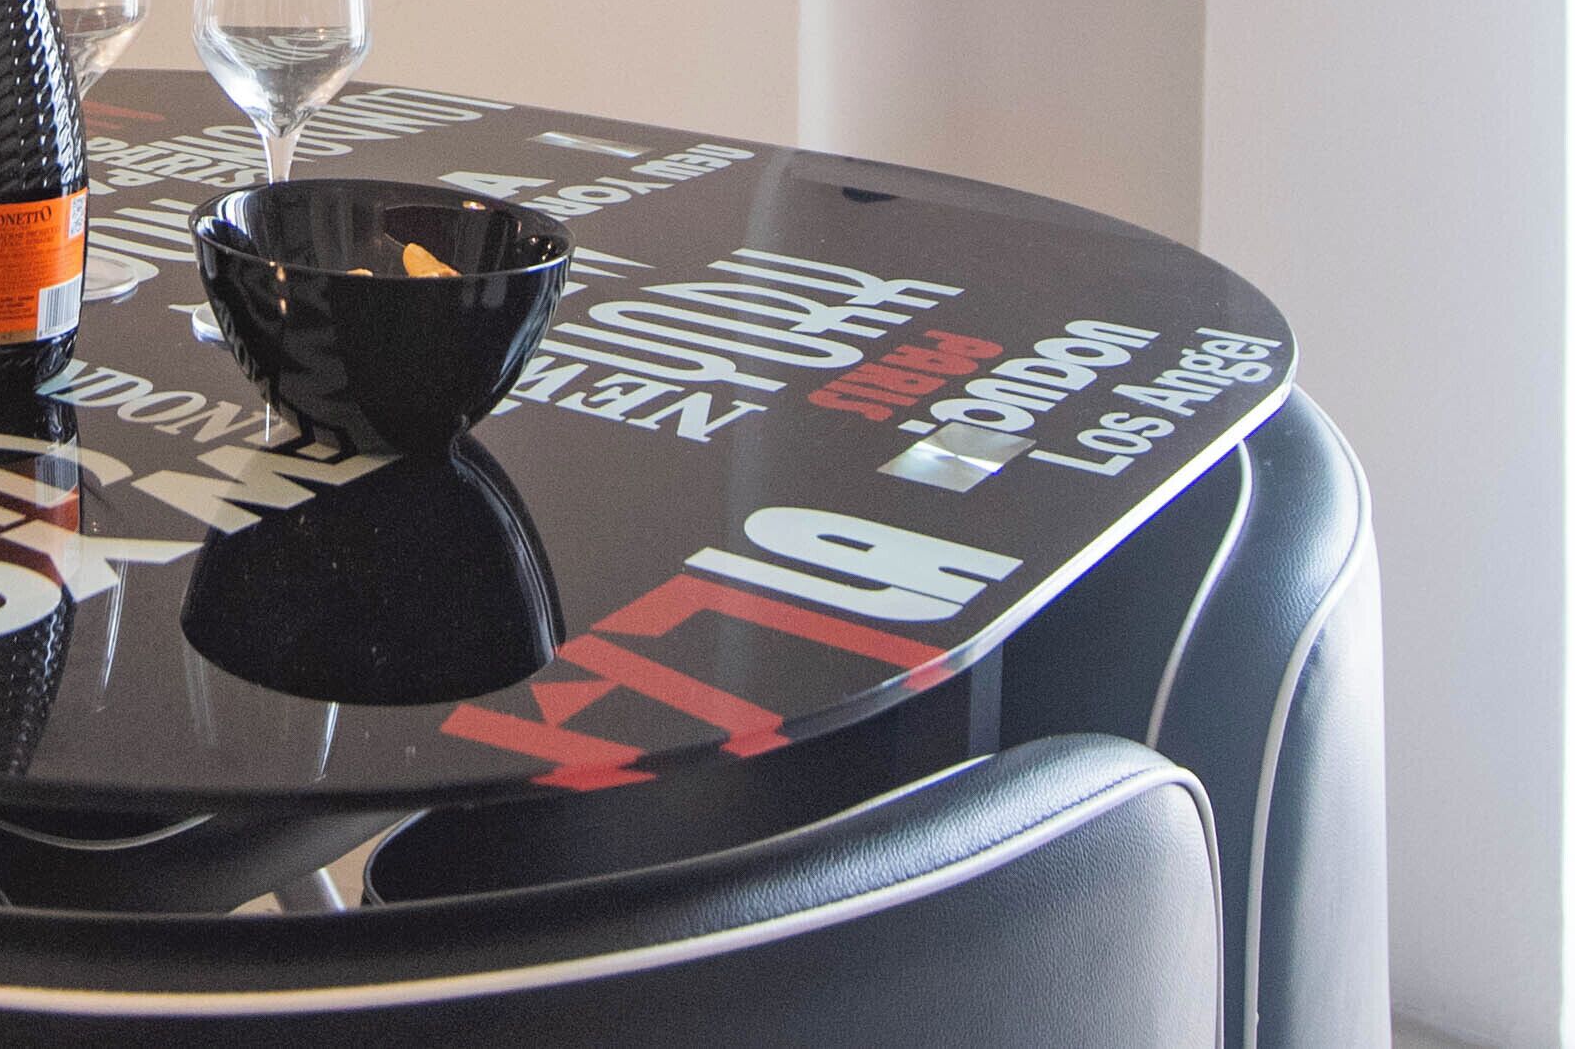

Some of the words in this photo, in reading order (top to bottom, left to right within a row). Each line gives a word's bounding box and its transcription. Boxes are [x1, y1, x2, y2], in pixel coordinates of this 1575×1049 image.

[807, 330, 1004, 421] PARIS
[1028, 412, 1176, 476] Los
[1112, 327, 1283, 417] Angel
